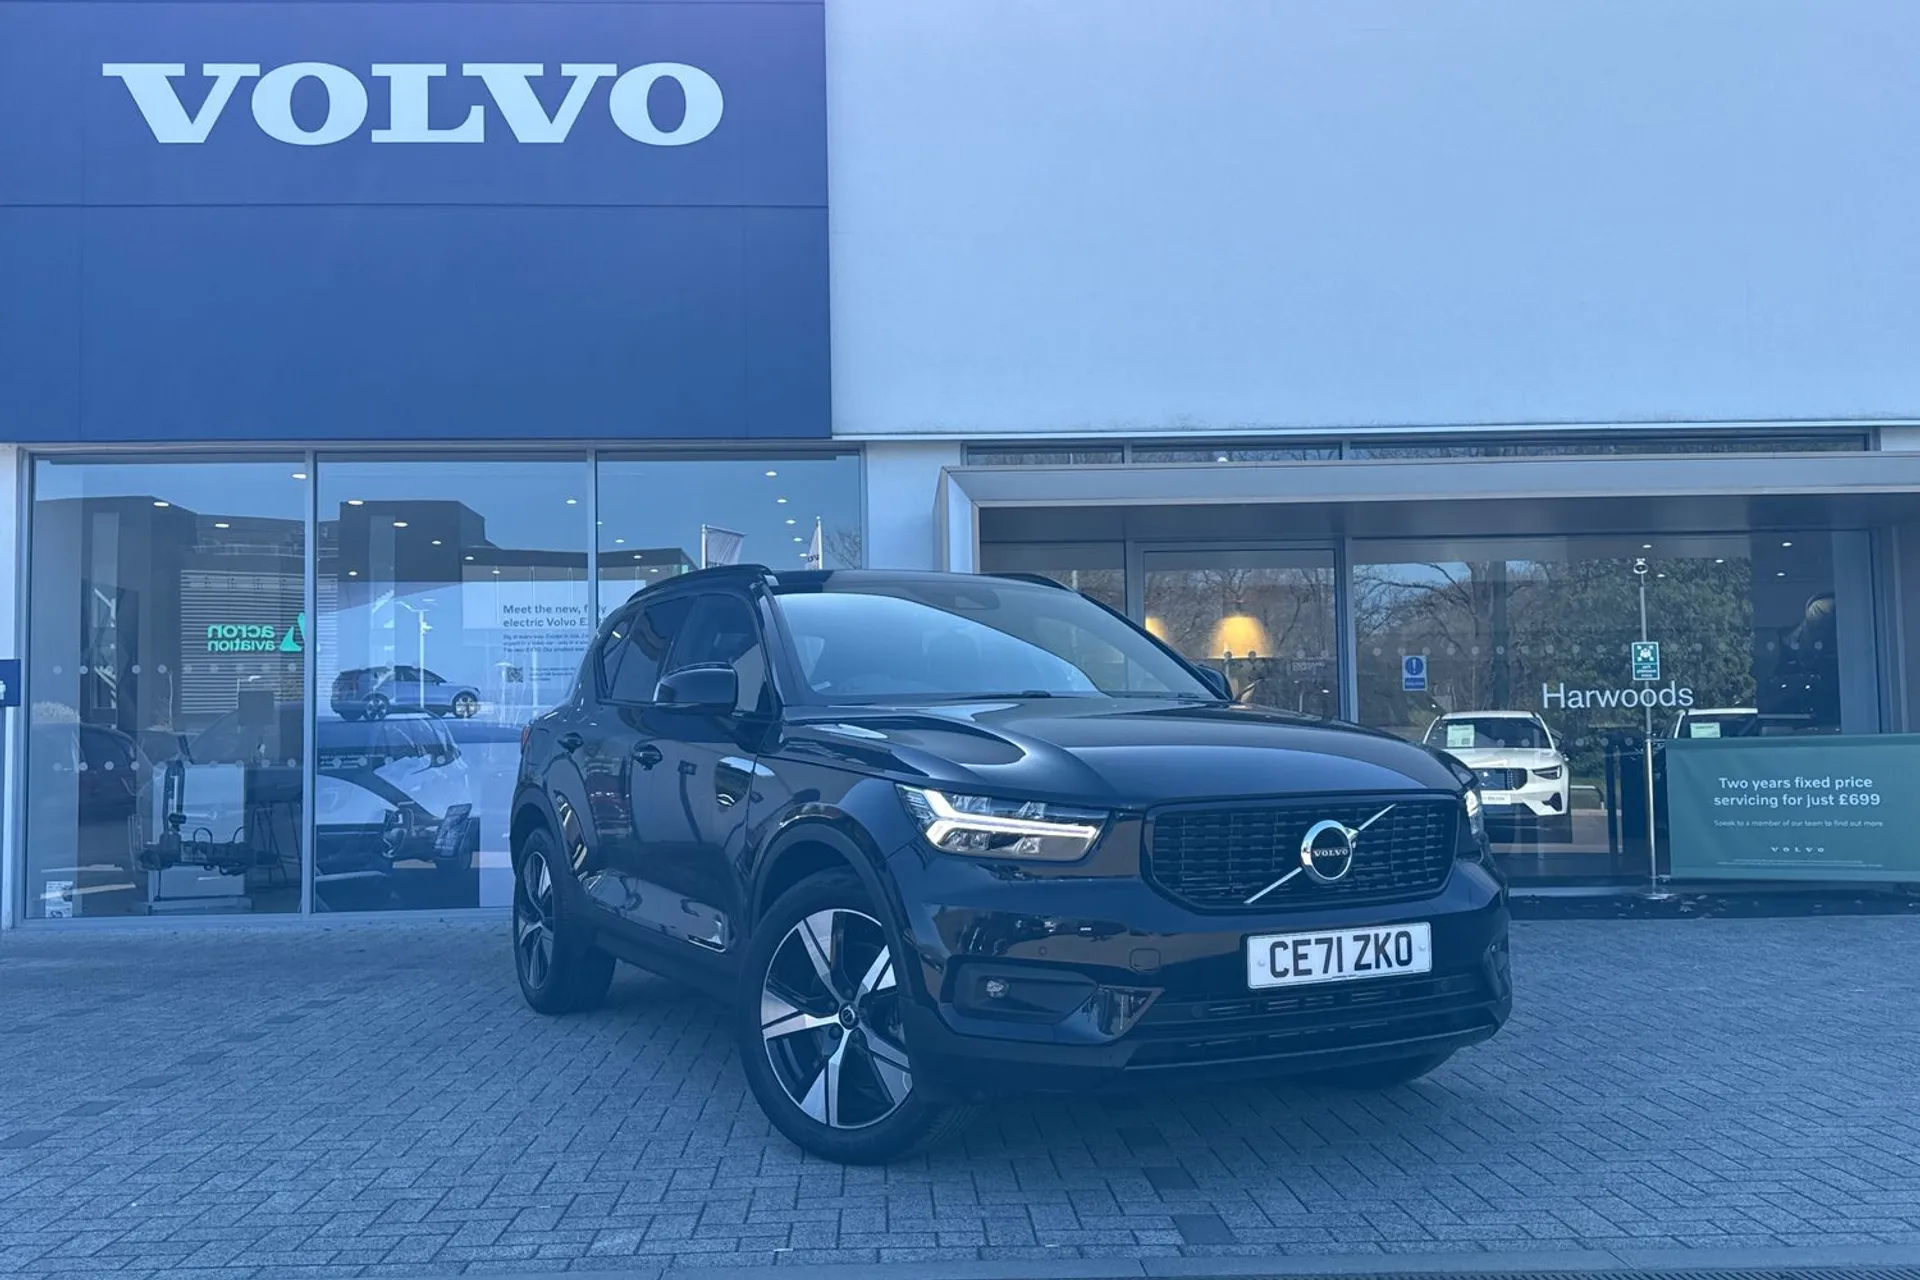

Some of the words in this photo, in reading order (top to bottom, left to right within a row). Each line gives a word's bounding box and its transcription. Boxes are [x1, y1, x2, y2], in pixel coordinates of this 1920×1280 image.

[102, 62, 724, 146] VOLVO
[503, 605, 532, 614] Meet
[535, 604, 552, 614] the
[556, 606, 582, 616] new,
[503, 618, 543, 627] electric
[547, 618, 577, 627] Volvo
[1543, 680, 1694, 708] Harwoods
[1718, 777, 1748, 789] Two
[1752, 778, 1791, 791] years
[1794, 776, 1831, 789] fixed
[1835, 776, 1873, 790] price
[1714, 794, 1778, 808] servicing
[1782, 793, 1803, 806] for
[1806, 793, 1834, 808] just
[1839, 793, 1881, 806] £699
[1713, 819, 1735, 828] Speak
[1752, 819, 1781, 827] member
[1782, 819, 1790, 827] of
[1804, 819, 1823, 827] team
[1824, 819, 1832, 827] to
[1833, 819, 1848, 827] find
[1313, 849, 1349, 857] VOLVO
[1269, 936, 1343, 978] CE71
[1353, 930, 1413, 971] ZKO
